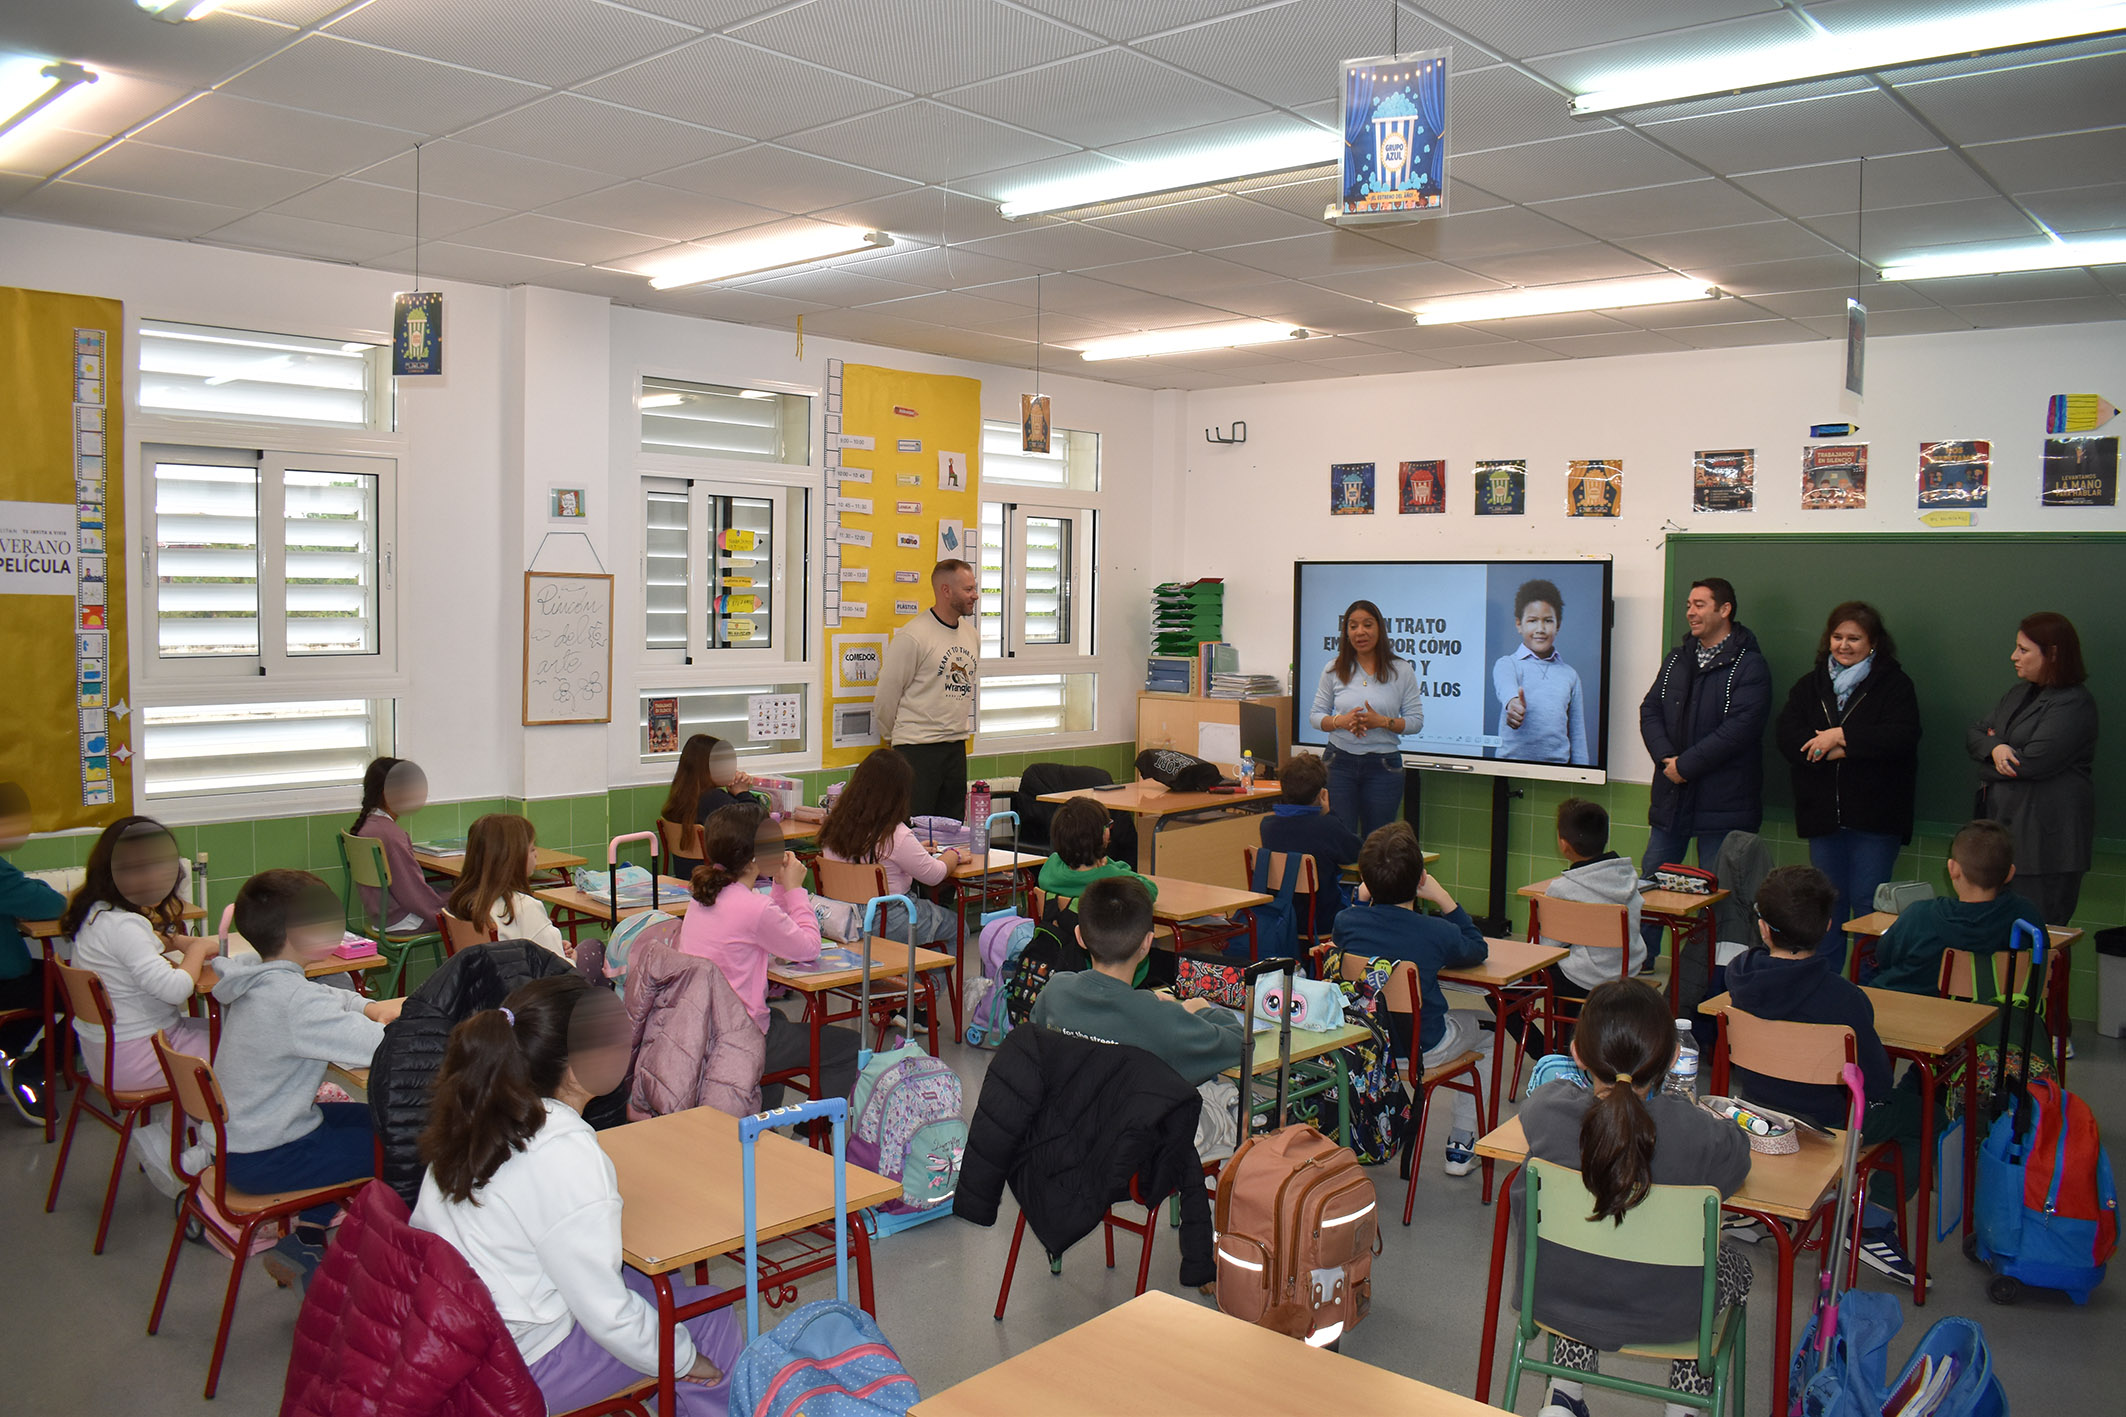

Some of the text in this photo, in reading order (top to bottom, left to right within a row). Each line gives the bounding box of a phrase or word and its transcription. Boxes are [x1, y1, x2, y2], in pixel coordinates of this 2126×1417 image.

[1386, 152, 1402, 161] AZUL
[2055, 479, 2103, 490] LA MANO
[2072, 489, 2102, 497] HABLAR
[0, 538, 71, 556] VERANO
[537, 584, 603, 615] Rincón
[554, 614, 587, 648] del
[1395, 617, 1447, 634] TRATO
[1388, 637, 1416, 655] POR
[1418, 635, 1462, 656] CÓMO
[537, 648, 583, 676] arte
[845, 653, 876, 661] COMEDOR
[937, 655, 949, 677] WEAR
[1420, 660, 1431, 676] Y
[945, 682, 972, 697] Wrangle
[1432, 681, 1462, 698] LOS
[1062, 1027, 1075, 1037] for
[1075, 1031, 1089, 1040] the
[1089, 1035, 1120, 1045] streets
